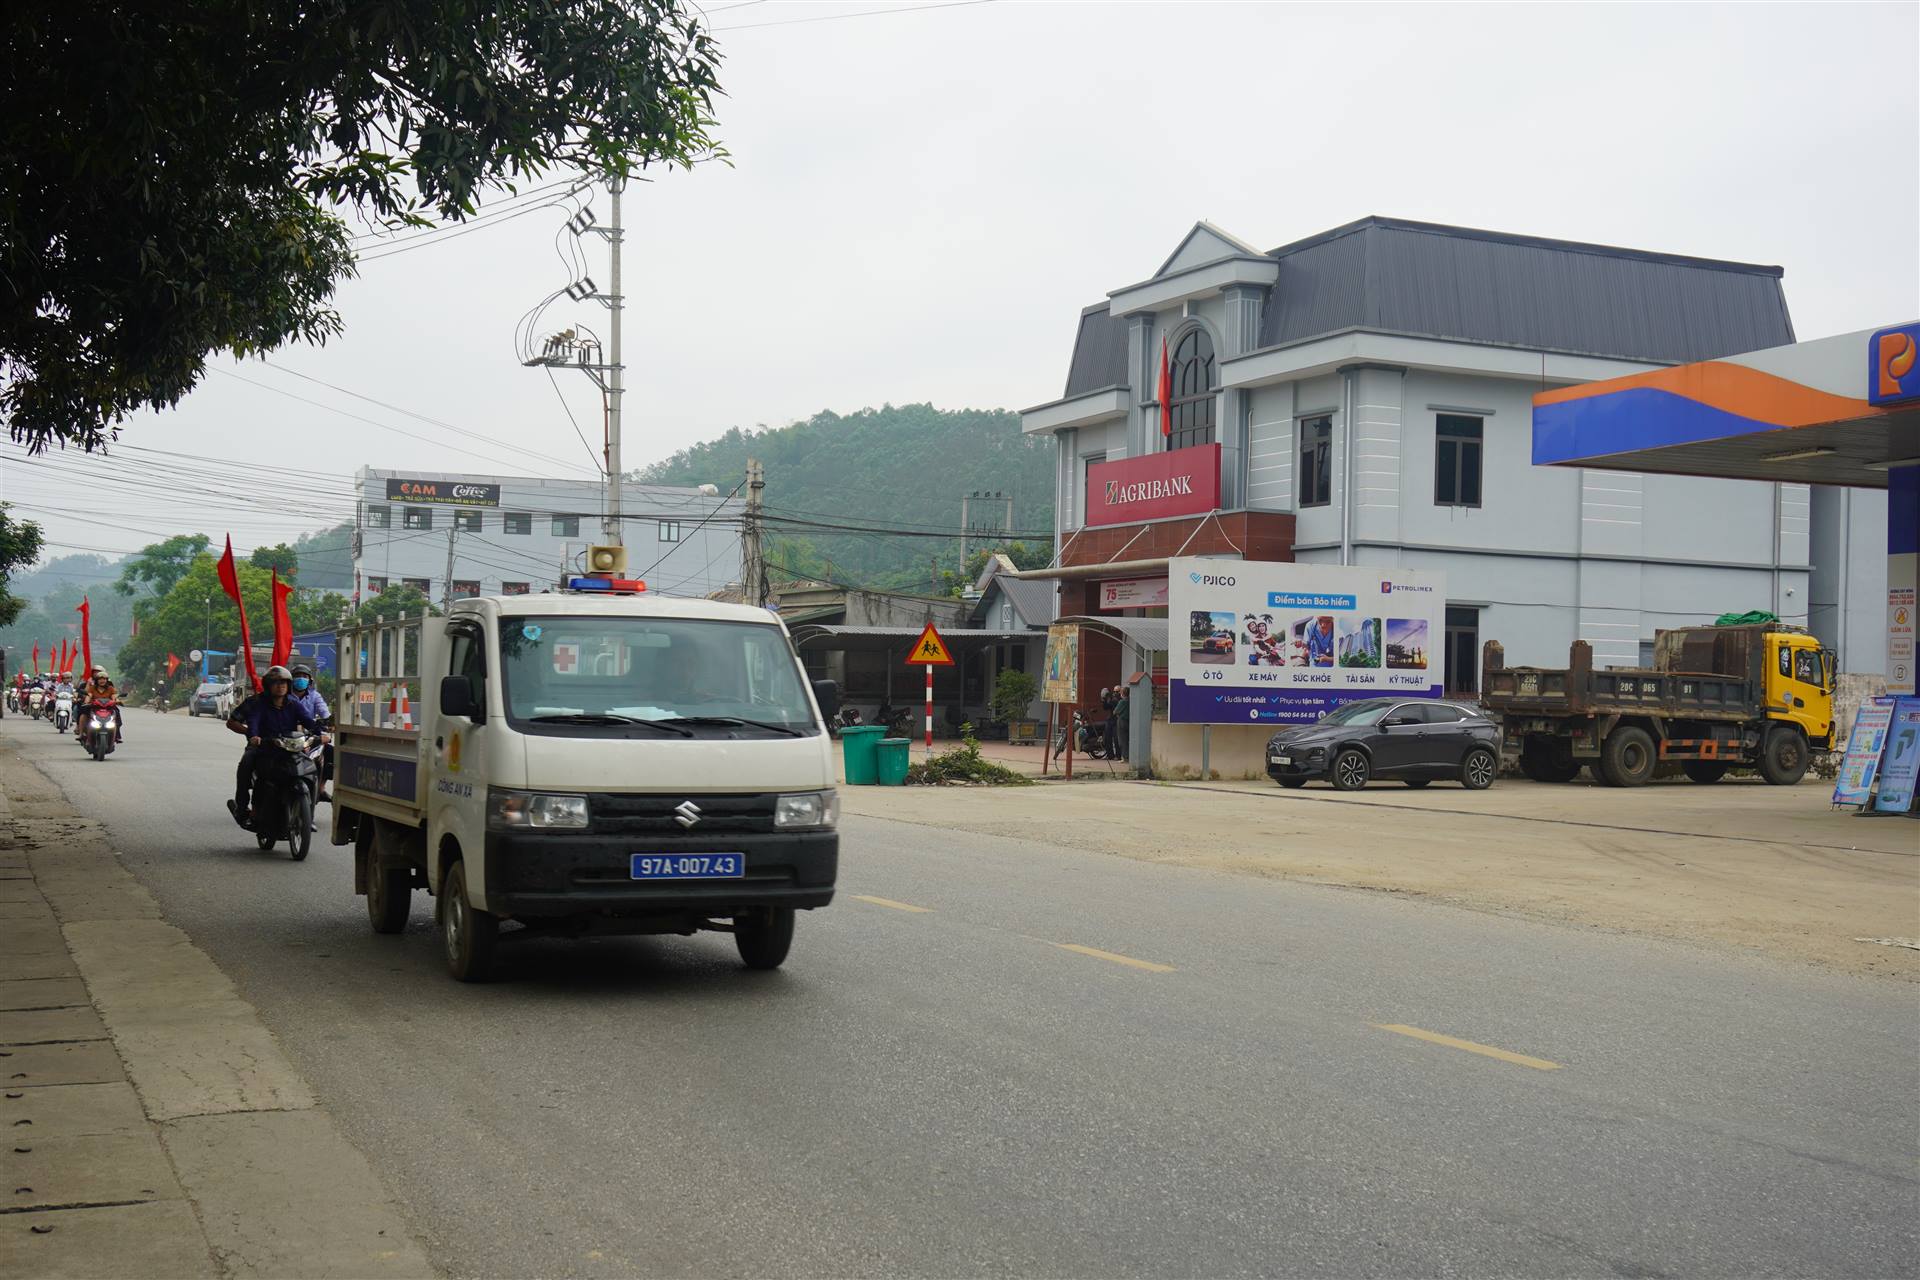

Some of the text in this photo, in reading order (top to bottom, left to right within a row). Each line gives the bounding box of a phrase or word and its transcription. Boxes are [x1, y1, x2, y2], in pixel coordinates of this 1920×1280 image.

[452, 484, 489, 498] Coffee
[1118, 475, 1192, 504] AGRIBANK
[1203, 575, 1236, 586] PJICO
[1106, 588, 1117, 600] 75
[1297, 596, 1313, 605] bán
[1203, 669, 1223, 680] Ô TÔ
[1248, 671, 1278, 681] XE MÁY
[1293, 673, 1332, 683] SỨC KHỎE
[1346, 674, 1375, 684] TÀI SẢN
[1401, 675, 1424, 686] THUẬT
[1620, 682, 1634, 692] 20C
[438, 777, 473, 798] CÔNG AN XÃ
[641, 857, 735, 874] 97A-007.43
